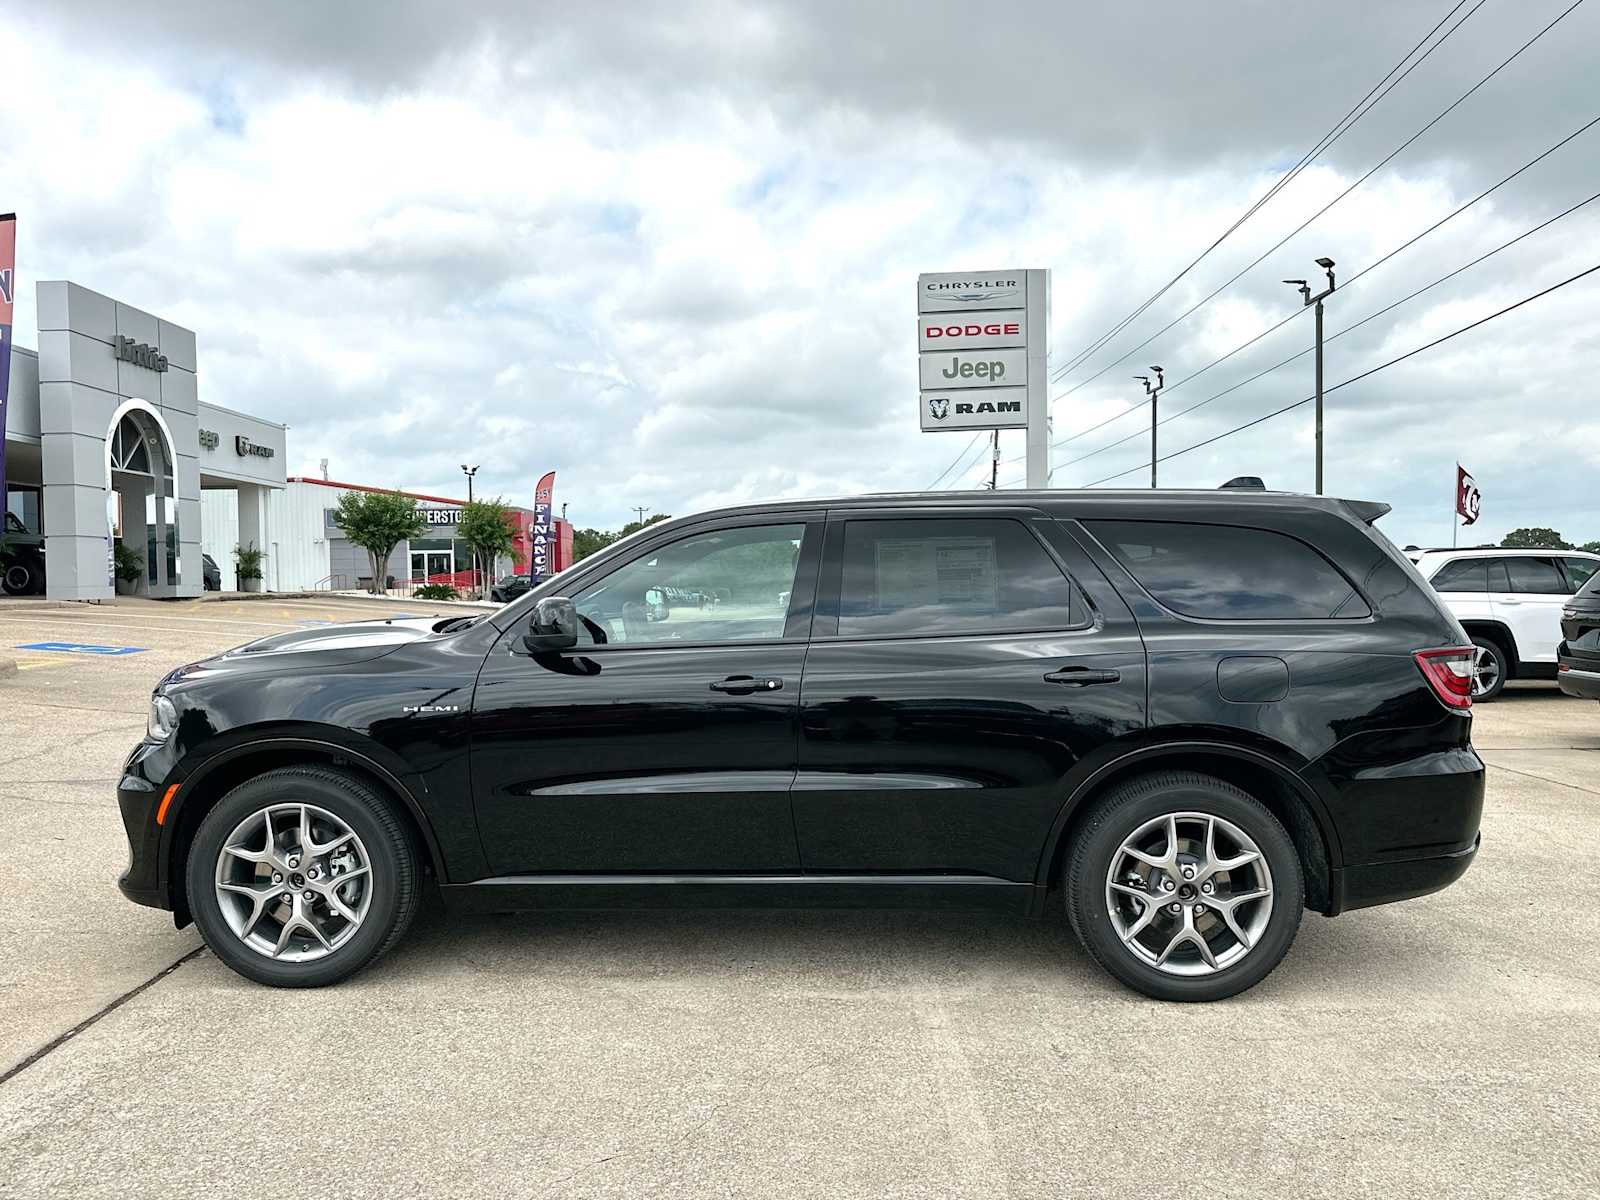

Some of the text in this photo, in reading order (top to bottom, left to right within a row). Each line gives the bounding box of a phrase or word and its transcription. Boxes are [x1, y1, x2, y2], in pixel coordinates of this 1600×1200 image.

[927, 280, 1017, 291] CHRYSLER
[926, 323, 1020, 338] DODGE
[942, 357, 1006, 382] Jeep
[955, 401, 1021, 414] RAM
[199, 429, 220, 451] eep
